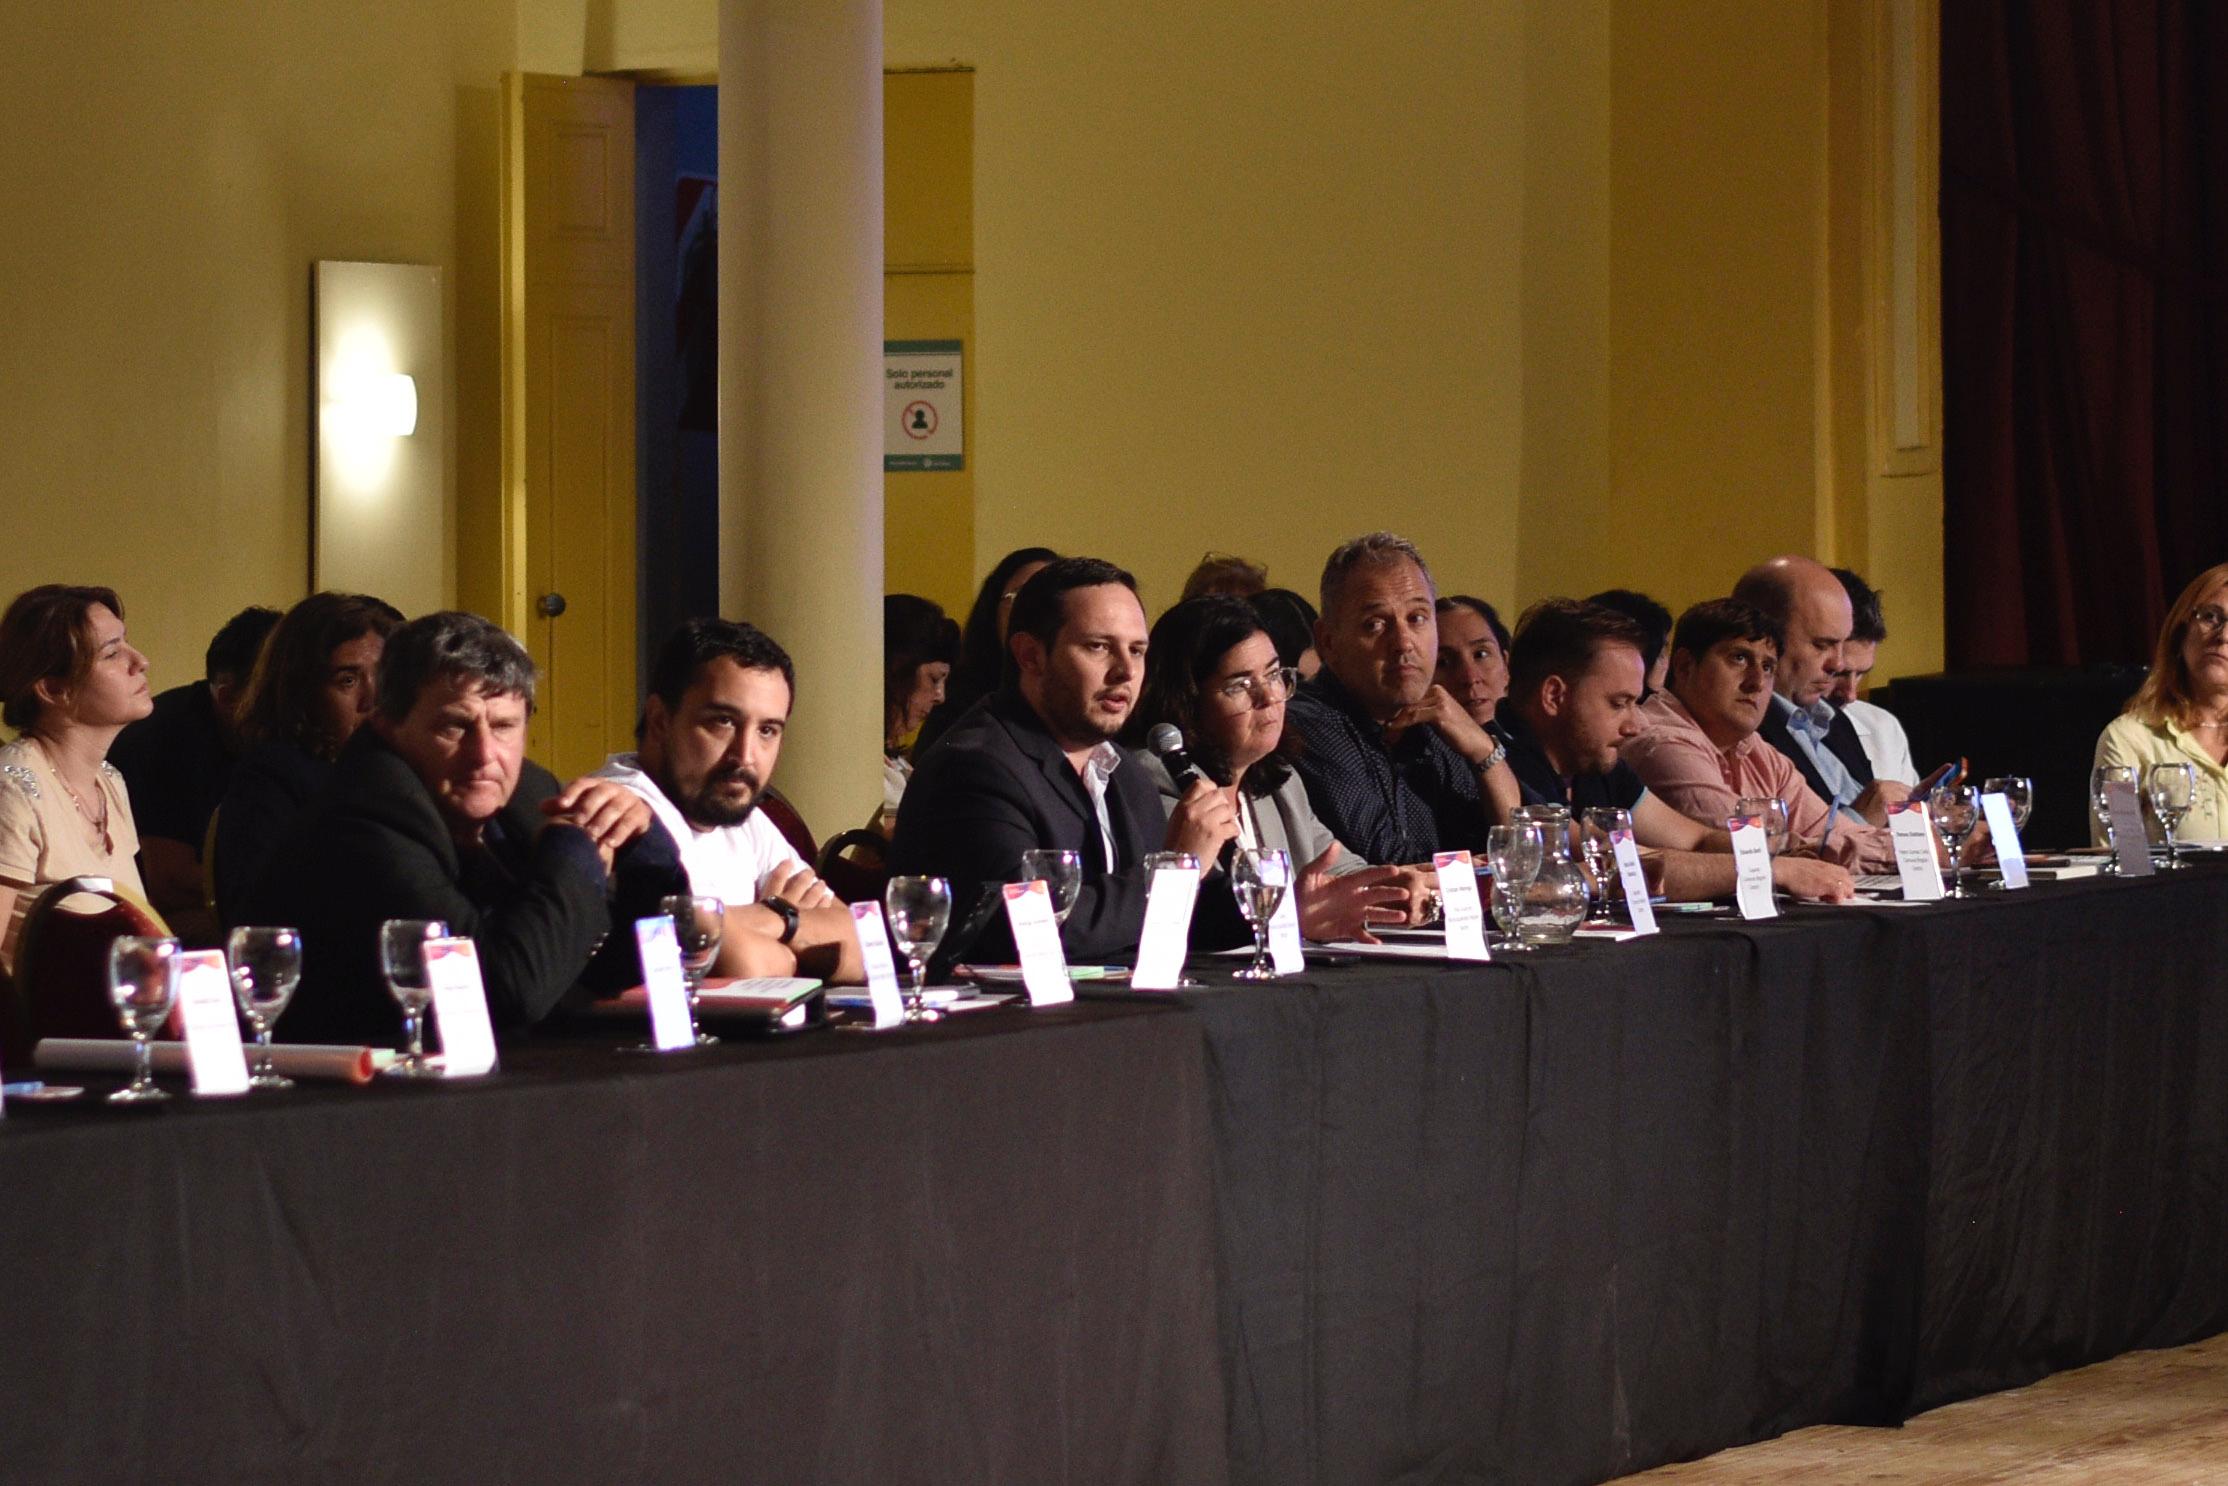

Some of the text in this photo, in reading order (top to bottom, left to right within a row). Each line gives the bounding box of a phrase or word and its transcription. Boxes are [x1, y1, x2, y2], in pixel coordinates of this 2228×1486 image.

[886, 368, 954, 381] Solo personal
[894, 380, 945, 390] autorizado
